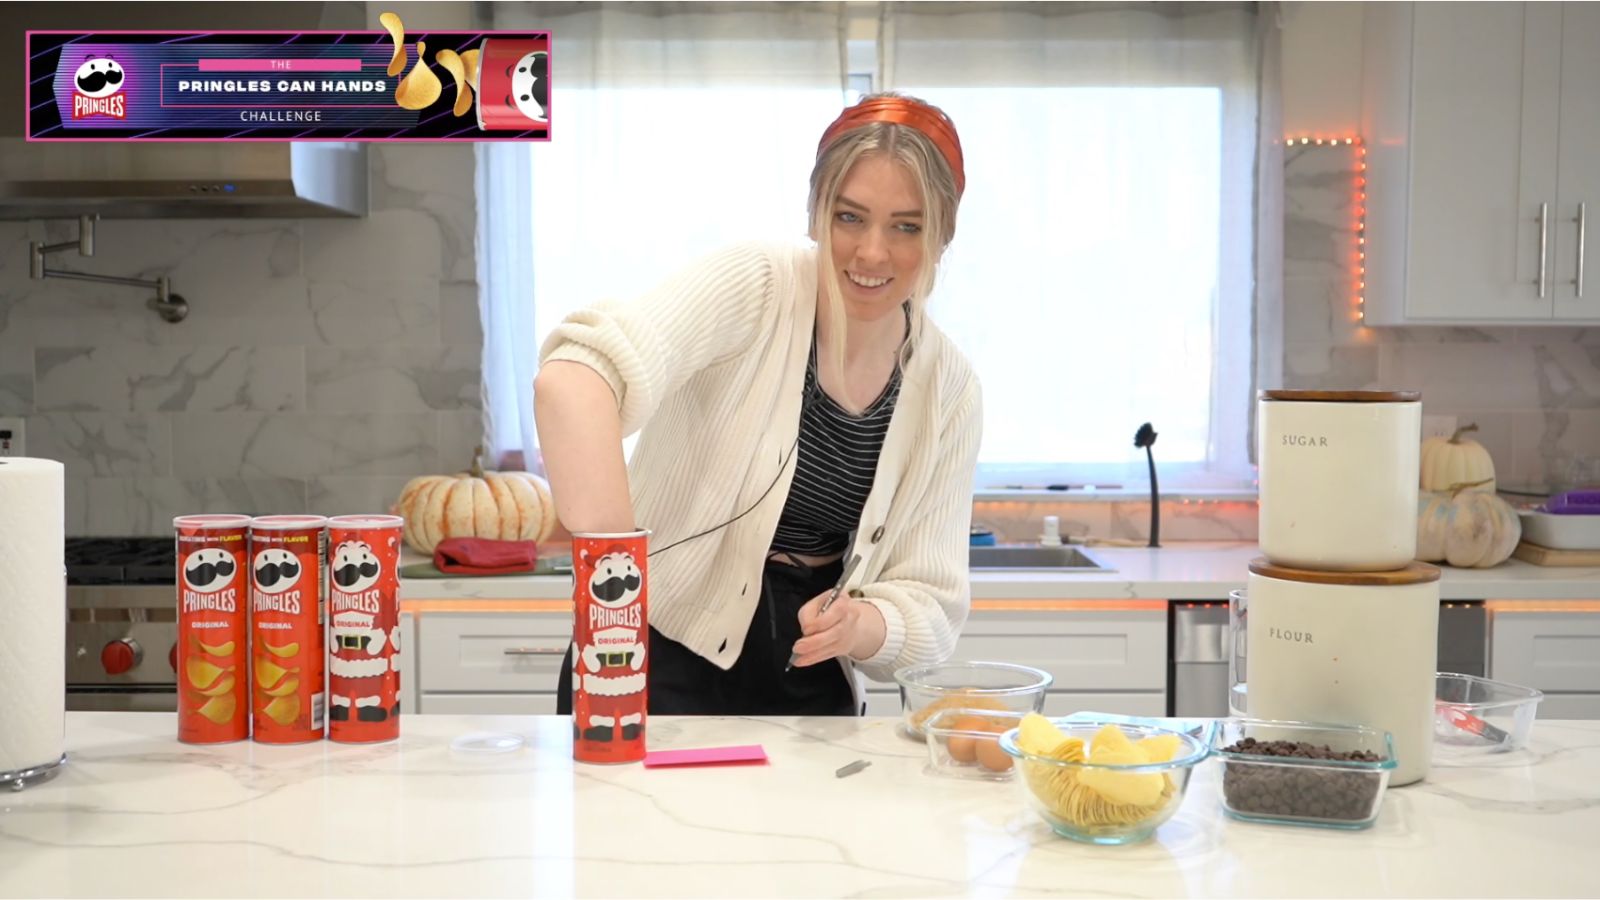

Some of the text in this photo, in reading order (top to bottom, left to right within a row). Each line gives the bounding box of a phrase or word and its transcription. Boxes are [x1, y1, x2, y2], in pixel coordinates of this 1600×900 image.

[1282, 434, 1328, 447] SUGAR
[183, 588, 236, 614] PRINGLES
[253, 589, 301, 615] PRINGLES
[331, 588, 380, 613] PRINGLES
[191, 621, 230, 629] ORIGINAL
[589, 602, 642, 630] PRINGLES
[597, 637, 635, 645] ORIGINAL
[1269, 627, 1313, 643] FLOUR
